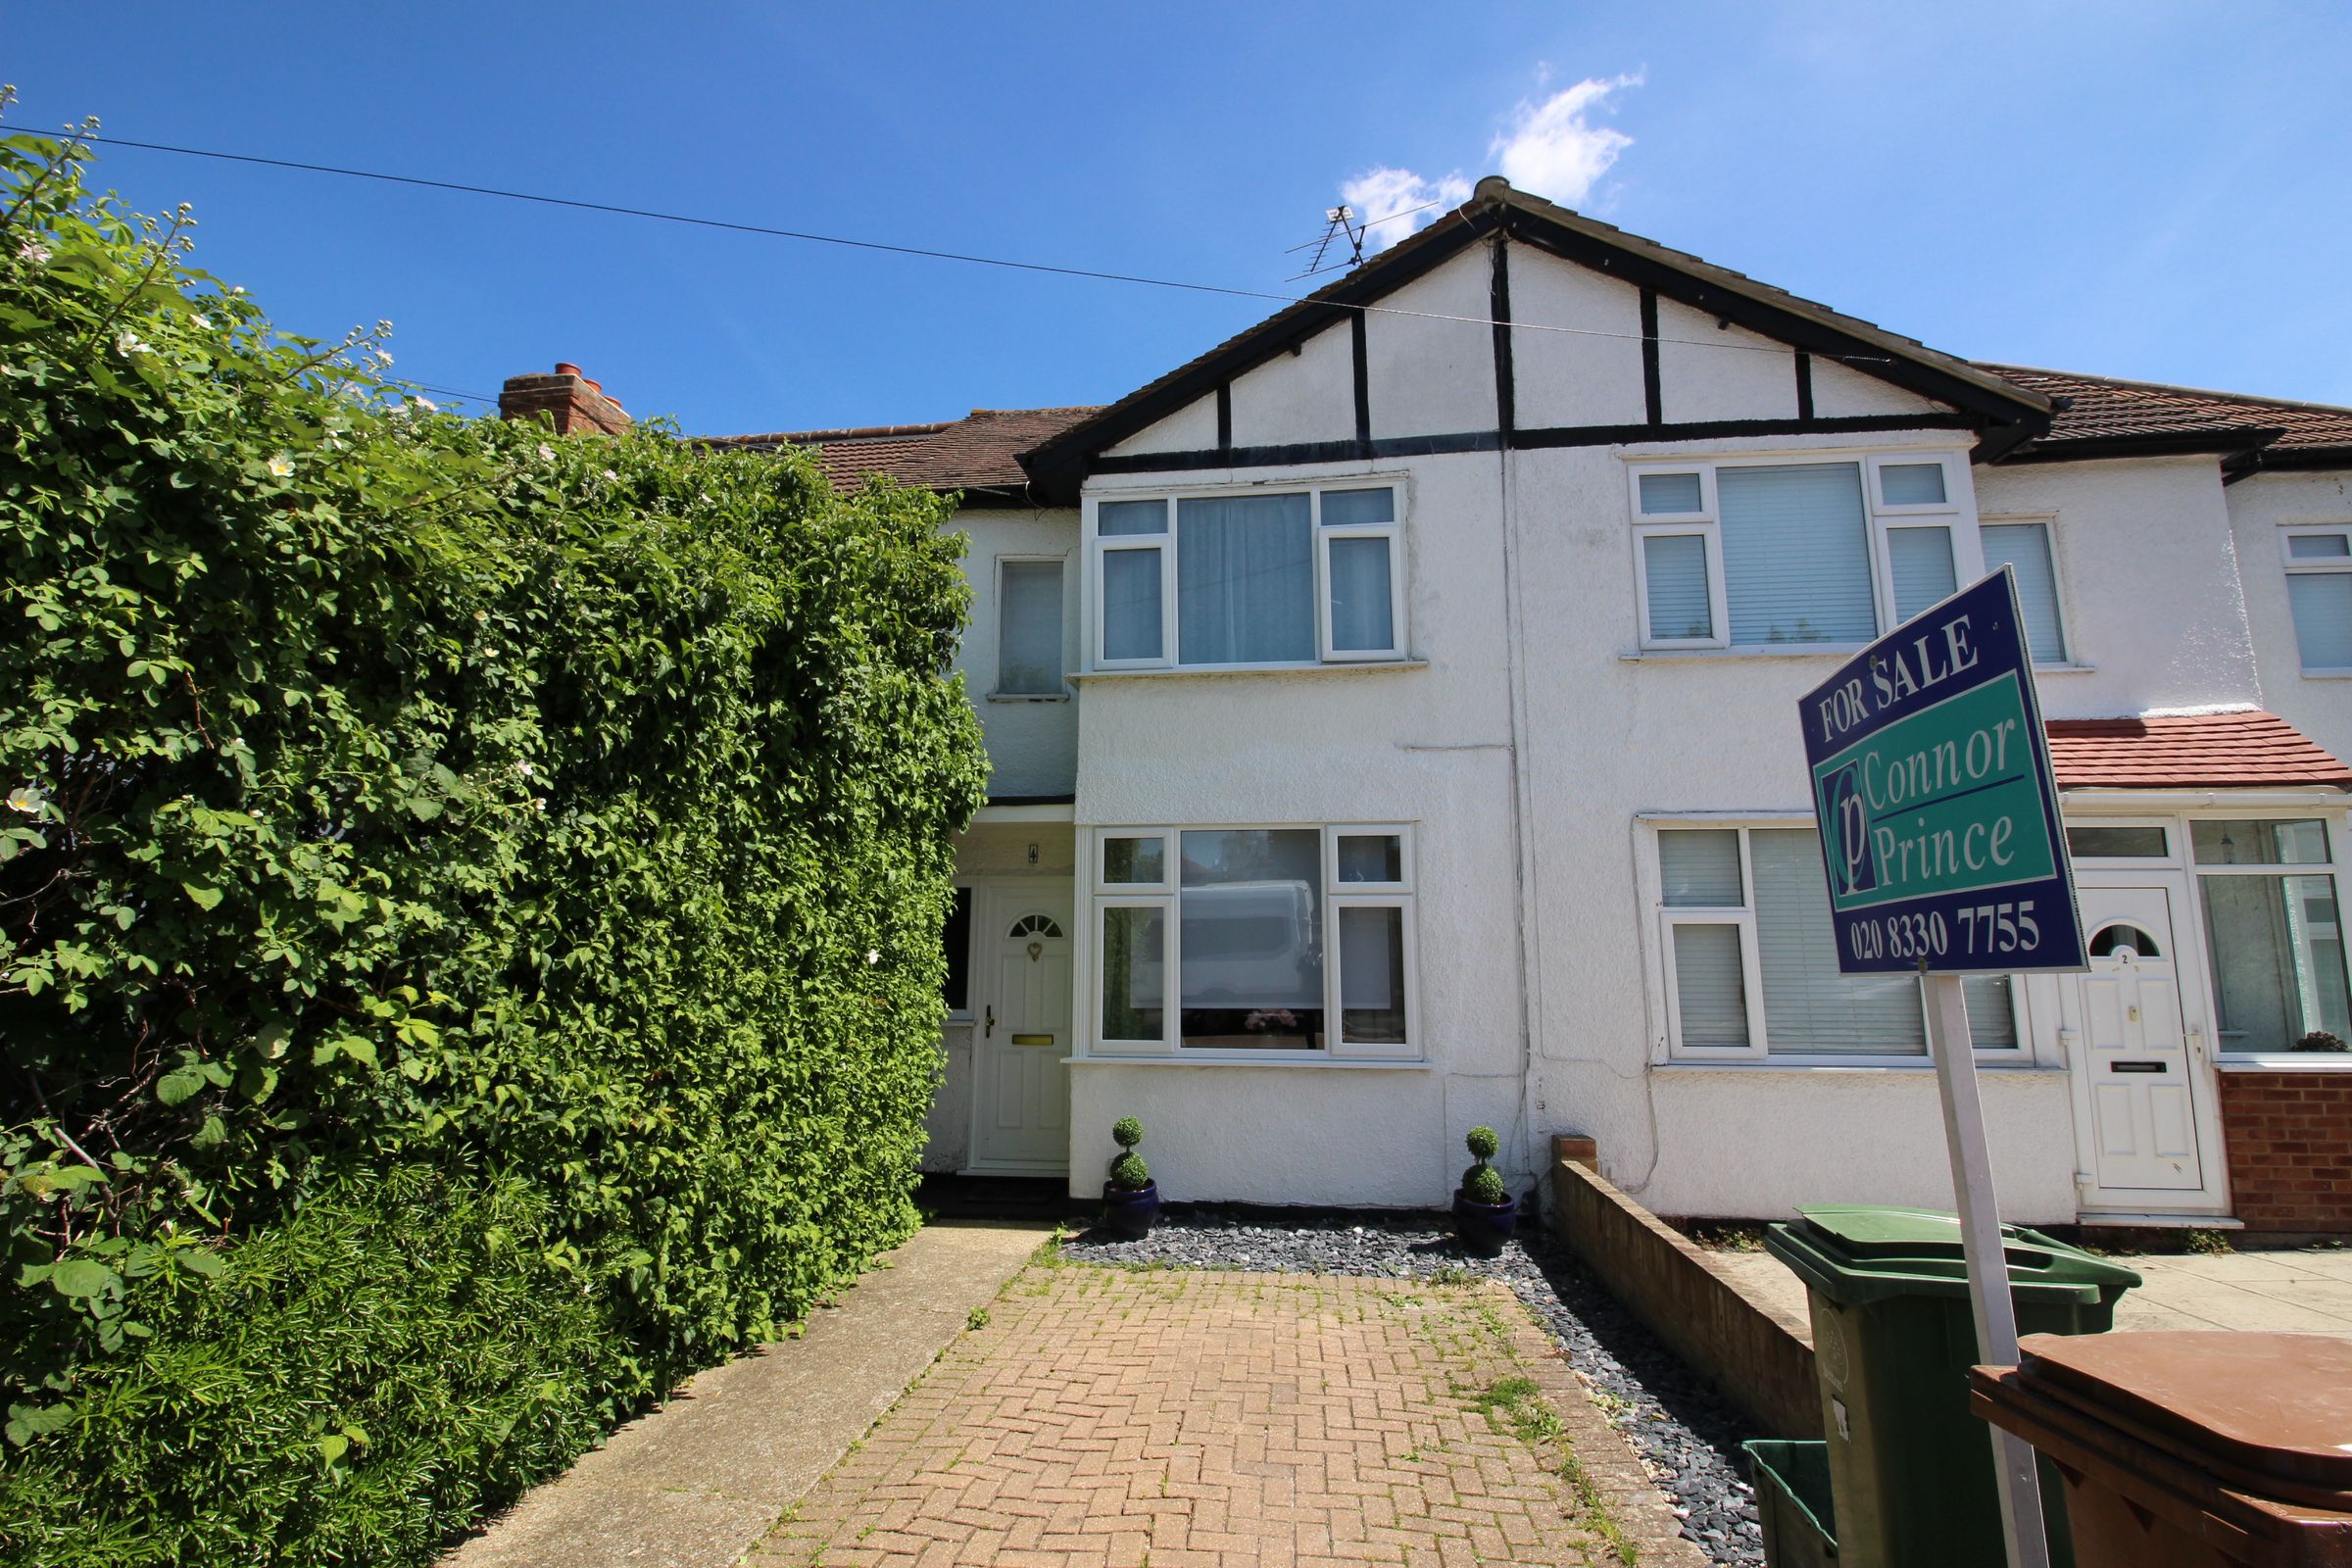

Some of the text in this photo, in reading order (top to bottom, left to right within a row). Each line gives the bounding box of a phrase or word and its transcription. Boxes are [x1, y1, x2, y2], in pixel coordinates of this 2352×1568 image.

[1819, 614, 1978, 743] FOR SALE
[1864, 718, 2016, 810] Connor
[1874, 815, 2015, 886] Prince
[1851, 900, 2039, 959] 020 8330 7755
[2122, 955, 2129, 964] 2
